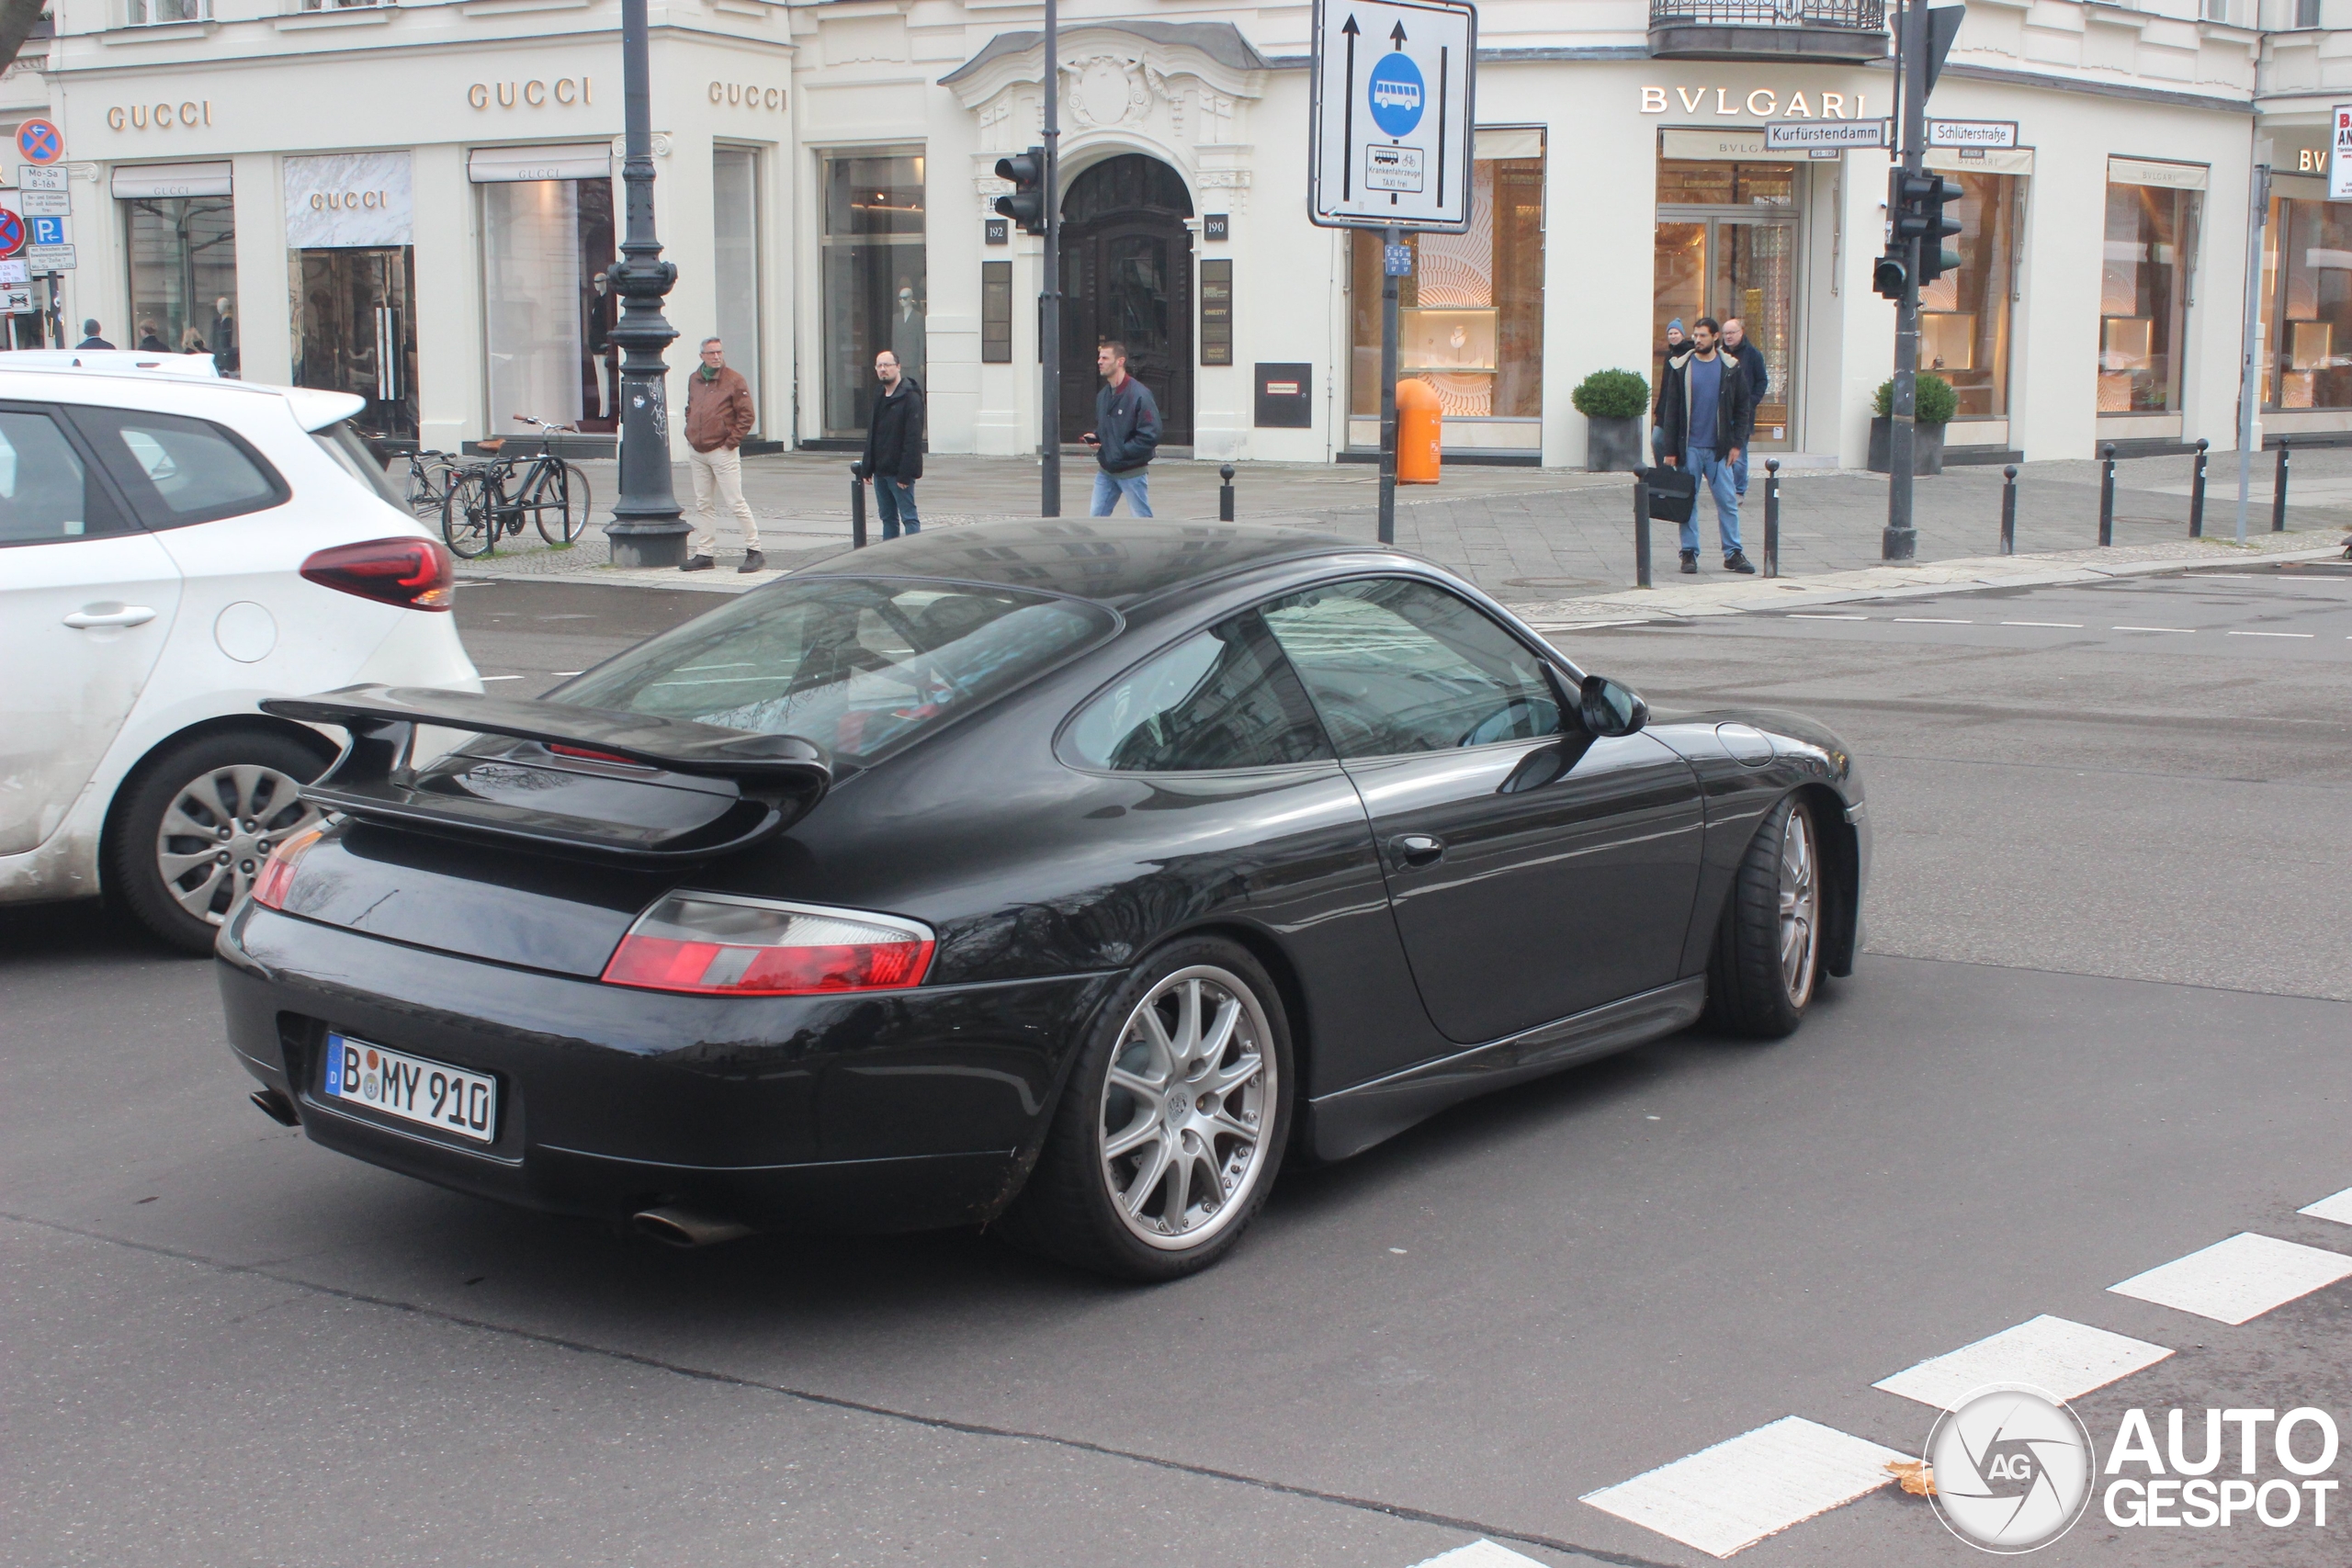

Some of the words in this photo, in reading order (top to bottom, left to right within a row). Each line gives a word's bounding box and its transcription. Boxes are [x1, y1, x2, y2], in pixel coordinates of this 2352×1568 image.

[468, 77, 591, 109] GUCCI
[707, 81, 787, 111] GUCCI
[1640, 86, 1864, 119] BVLGARI
[107, 101, 210, 130] GUCCI
[2340, 114, 2352, 128] B
[1773, 128, 1878, 141] Kurfürstendamm
[1938, 125, 2006, 143] Schlüterstraße
[1958, 157, 1997, 166] BVLGARI
[28, 168, 58, 178] Mo-Sa
[518, 169, 560, 179] GUCCI
[1368, 166, 1420, 179] Krankenfahrzeuge
[2143, 171, 2176, 182] BVLGARI
[32, 179, 56, 188] 8-16h
[1383, 178, 1395, 186] TAXI
[1396, 180, 1408, 188] frei
[153, 186, 189, 196] GUCCI
[310, 190, 386, 210] GUCCI
[38, 220, 54, 242] P
[989, 227, 1003, 237] 192
[1208, 221, 1225, 232] 190
[330, 1070, 337, 1084] D
[343, 1046, 360, 1093] B
[381, 1057, 422, 1111] MY
[430, 1071, 489, 1131] 910
